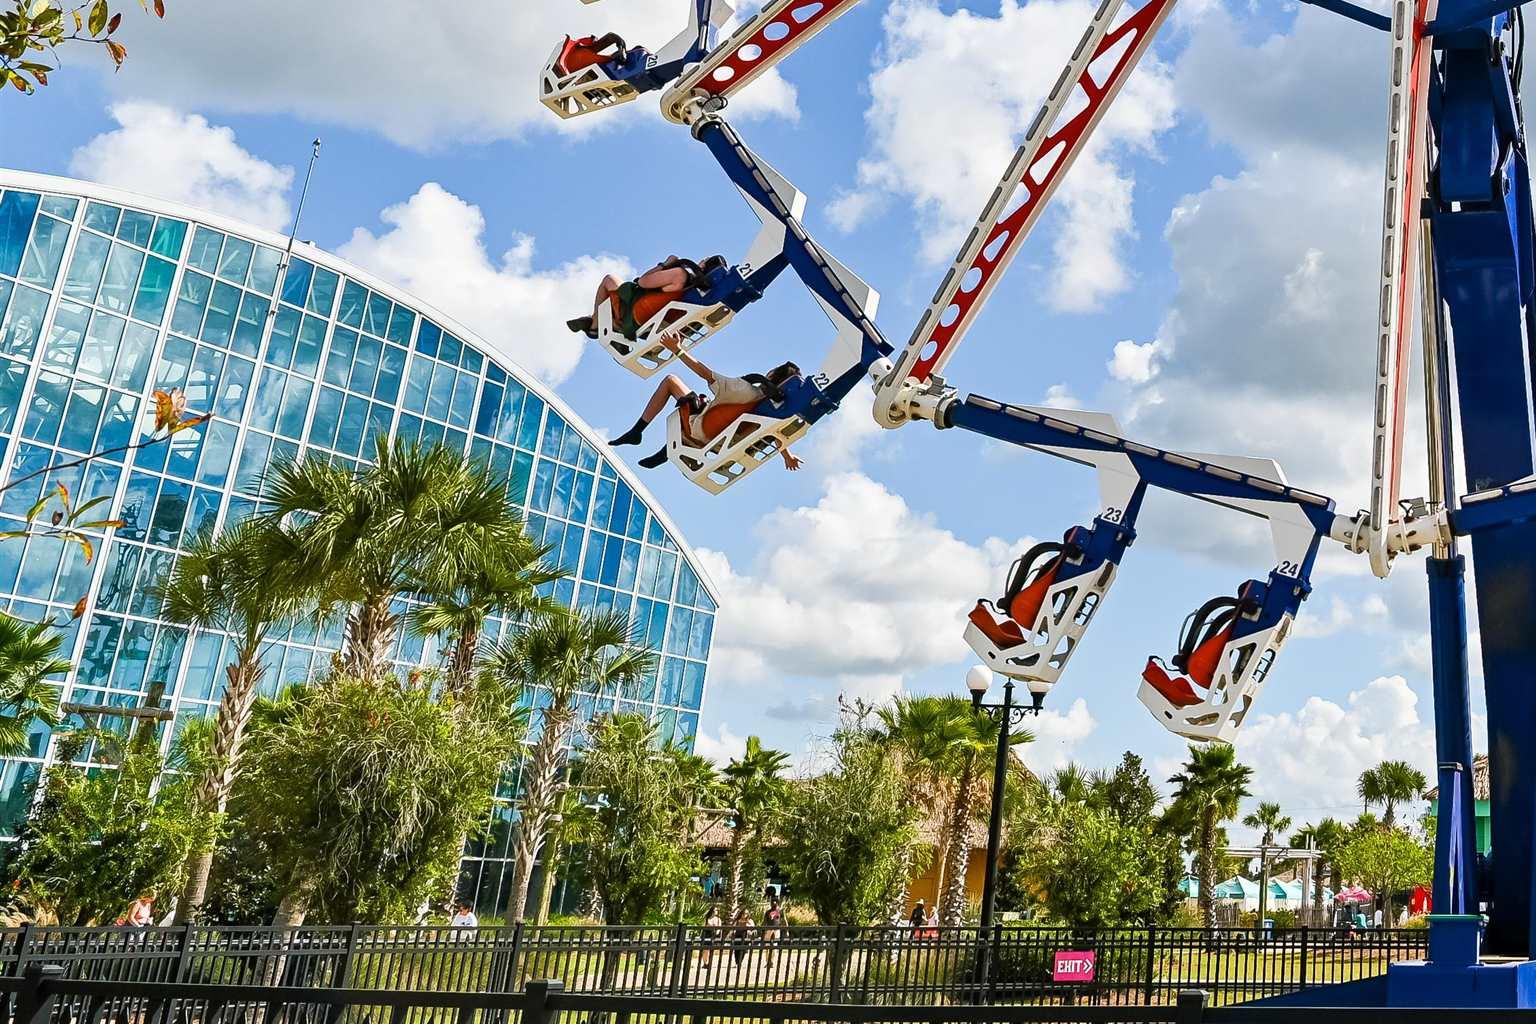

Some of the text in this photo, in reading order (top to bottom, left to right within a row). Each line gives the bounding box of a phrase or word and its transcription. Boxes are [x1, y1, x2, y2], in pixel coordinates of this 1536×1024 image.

[647, 55, 658, 68] 20
[739, 262, 754, 277] 21
[813, 372, 830, 389] 22
[1103, 506, 1122, 523] 23
[1279, 560, 1299, 577] 24
[1057, 959, 1083, 973] EXIT
